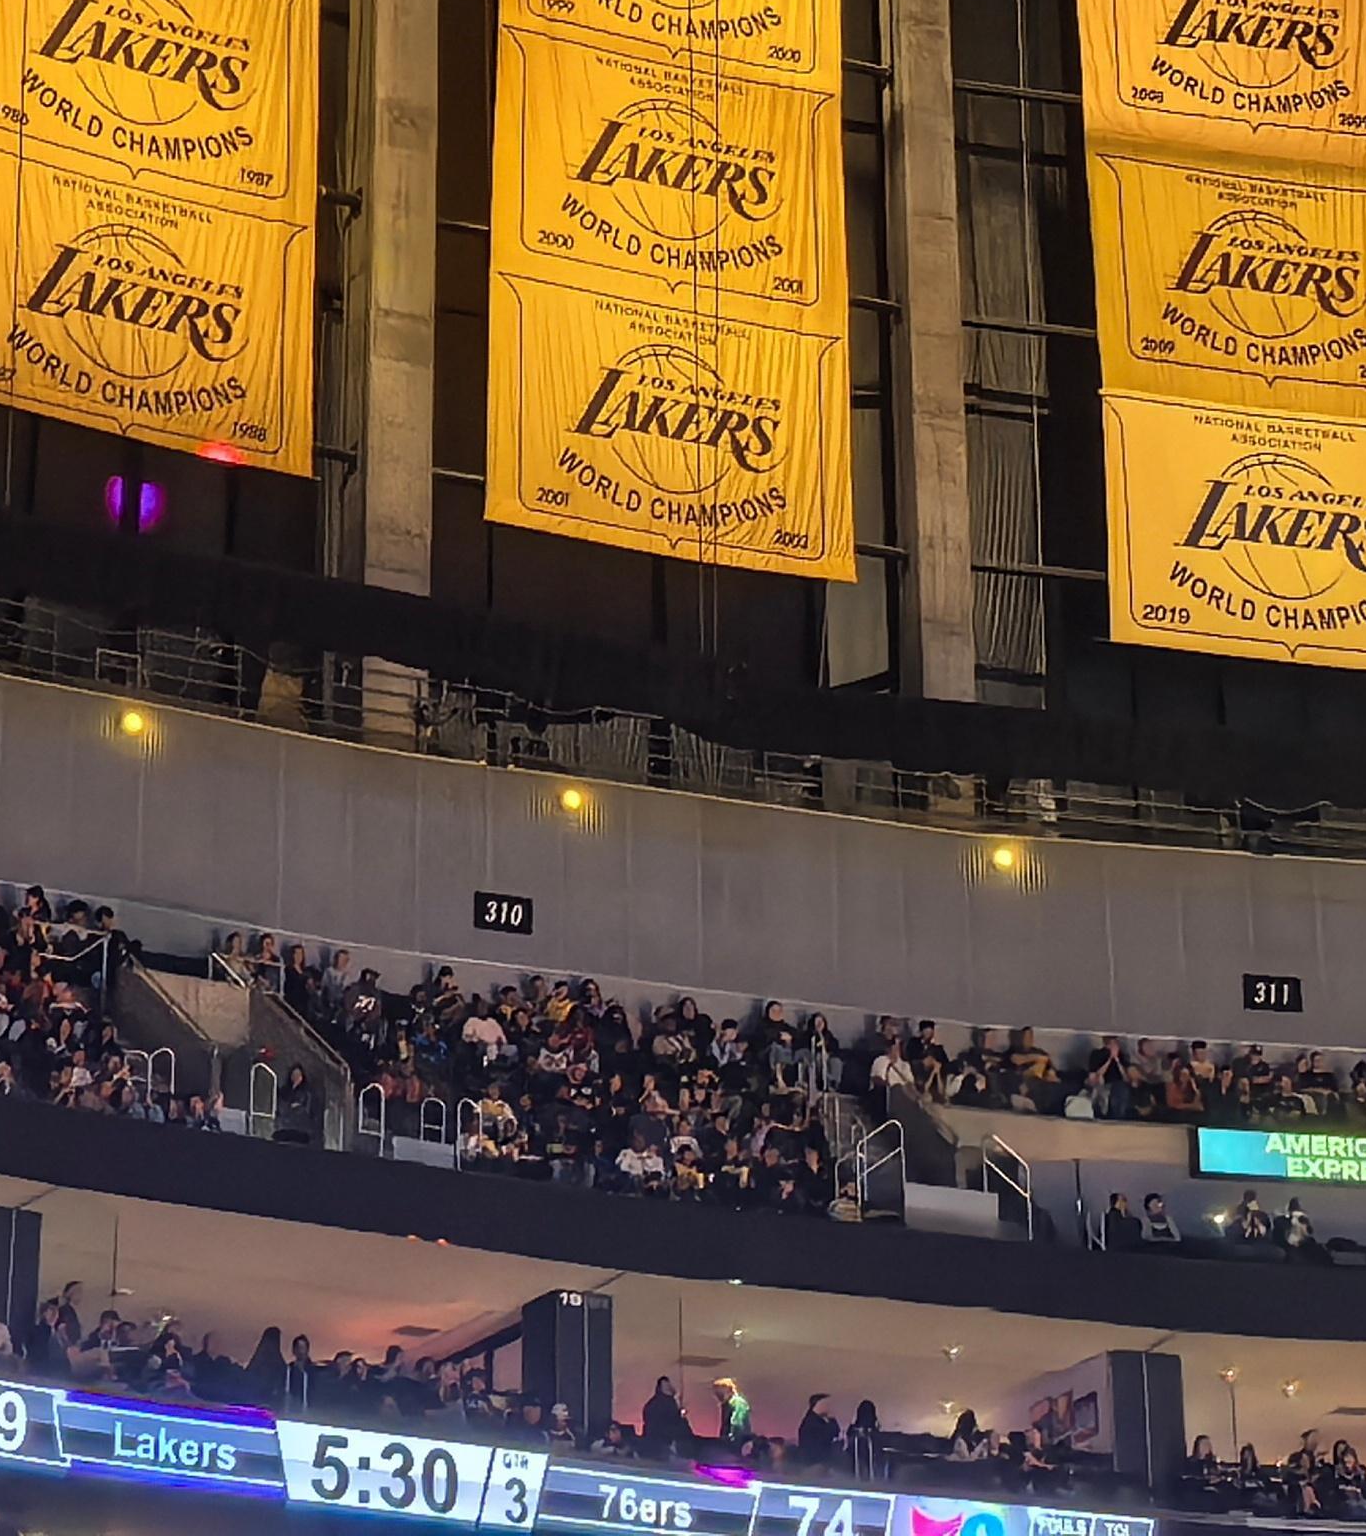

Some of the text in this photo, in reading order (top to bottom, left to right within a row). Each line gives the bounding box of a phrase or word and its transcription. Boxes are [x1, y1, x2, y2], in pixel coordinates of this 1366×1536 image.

[105, 4, 144, 23] LOS
[653, 6, 781, 41] CHAMPIONS
[767, 45, 801, 63] 2000
[1151, 54, 1350, 113] WORLD CHAMPIONS
[23, 68, 253, 161] WORLD CHAMPIONS
[239, 168, 273, 188] 1987
[566, 117, 784, 221] LAKERS
[537, 231, 574, 250] 2000
[561, 192, 783, 272] WORLD CHAMPIONS
[1227, 237, 1263, 251] LOS
[18, 243, 249, 362] LAKERS
[773, 276, 803, 295] 2001
[1162, 301, 1236, 356] WORLD
[7, 324, 246, 415] WORLD CHAMPIONS
[637, 375, 674, 392] LOS
[565, 366, 787, 473] LAKERS
[535, 487, 569, 507] 2001
[558, 447, 787, 528] WORLD CHAMPIONS
[1244, 483, 1283, 499] LOS
[1169, 561, 1256, 620] WORLD
[1143, 604, 1191, 624] 2019
[485, 900, 523, 926] 310
[1254, 981, 1289, 1005] 311
[113, 1421, 237, 1472] Lakers
[311, 1433, 458, 1515] 5:30
[505, 1477, 528, 1524] 3
[598, 1483, 692, 1528] 76ers
[787, 1495, 857, 1536] 74
